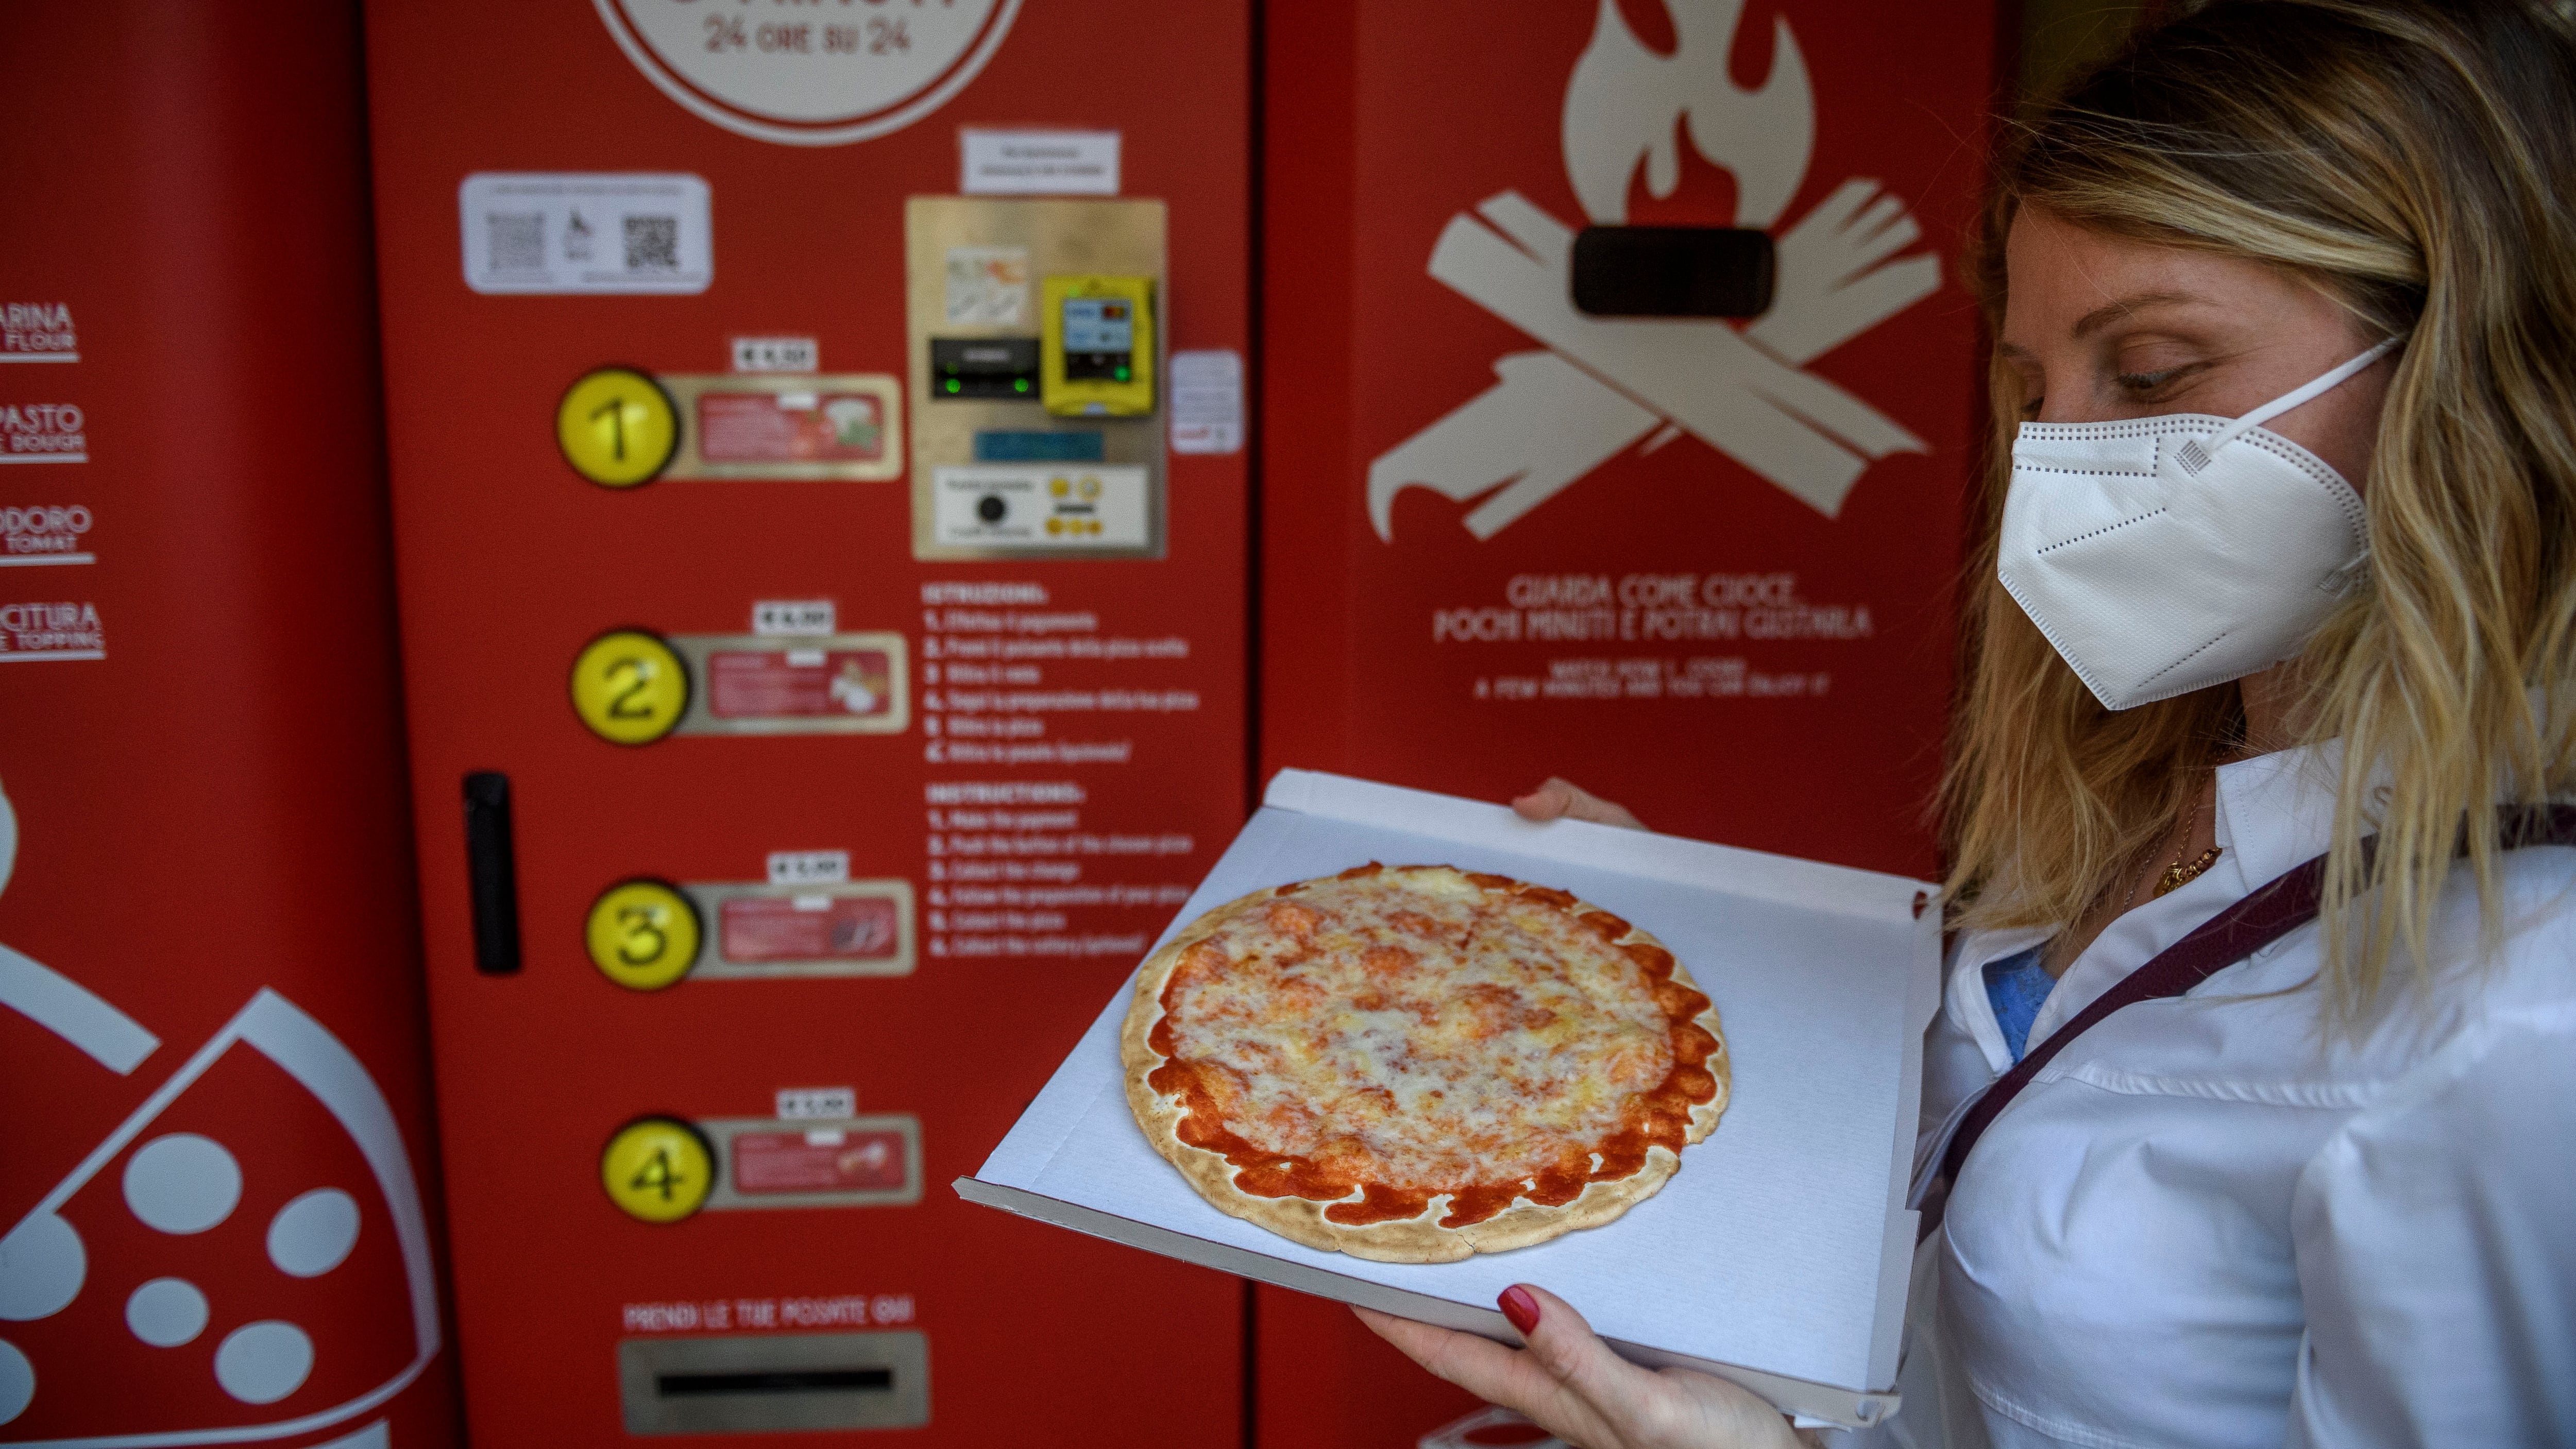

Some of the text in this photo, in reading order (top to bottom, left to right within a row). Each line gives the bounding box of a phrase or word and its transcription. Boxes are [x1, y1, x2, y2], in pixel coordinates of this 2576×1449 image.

[703, 13, 913, 56] 24 ORE SU 24
[5, 330, 78, 351] FLOUR
[587, 395, 628, 464] 1
[0, 504, 93, 535] DORO
[1507, 574, 1615, 606] GUARDA
[1620, 574, 1699, 606] COME
[1434, 605, 1871, 641] POCHI MINUTI E POTRAI GUSTARLA
[601, 655, 654, 721] 2
[1494, 677, 1539, 699] FEW
[1544, 676, 1621, 698] MINUTES
[617, 904, 668, 968] 3
[626, 1145, 685, 1203] 4
[623, 1303, 700, 1329] PRENDI
[703, 1301, 732, 1328] LE
[735, 1299, 775, 1326] TUE
[781, 1295, 869, 1324] POSATE
